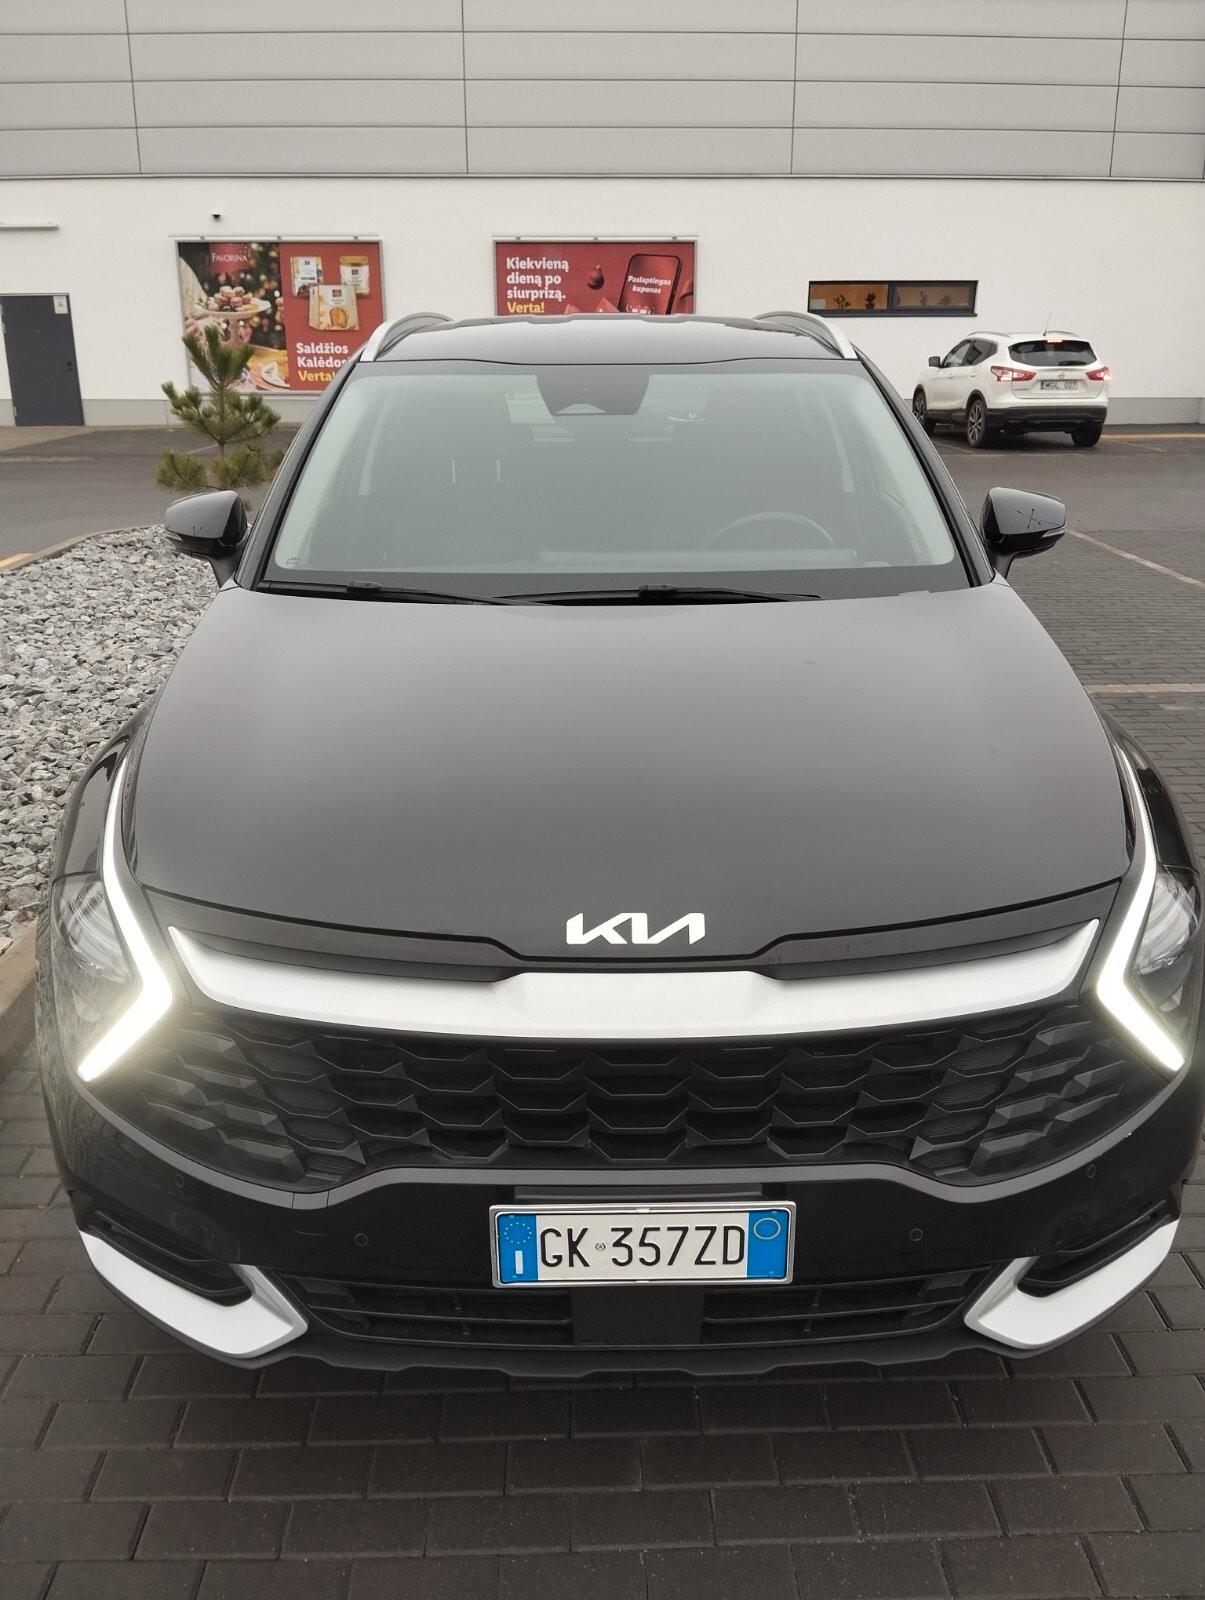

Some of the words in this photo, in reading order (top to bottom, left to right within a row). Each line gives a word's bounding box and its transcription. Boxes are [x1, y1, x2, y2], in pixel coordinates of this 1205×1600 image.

[506, 257, 569, 272] Kiekvieną
[506, 272, 542, 287] dieną
[545, 274, 561, 285] po
[507, 287, 566, 301] siurprizą.
[632, 284, 662, 294] kuponas
[507, 301, 545, 313] Verta!
[296, 342, 349, 354] Saldžios
[566, 912, 706, 945] KIA
[540, 1227, 590, 1268] GK
[610, 1225, 745, 1267] 357ZD
